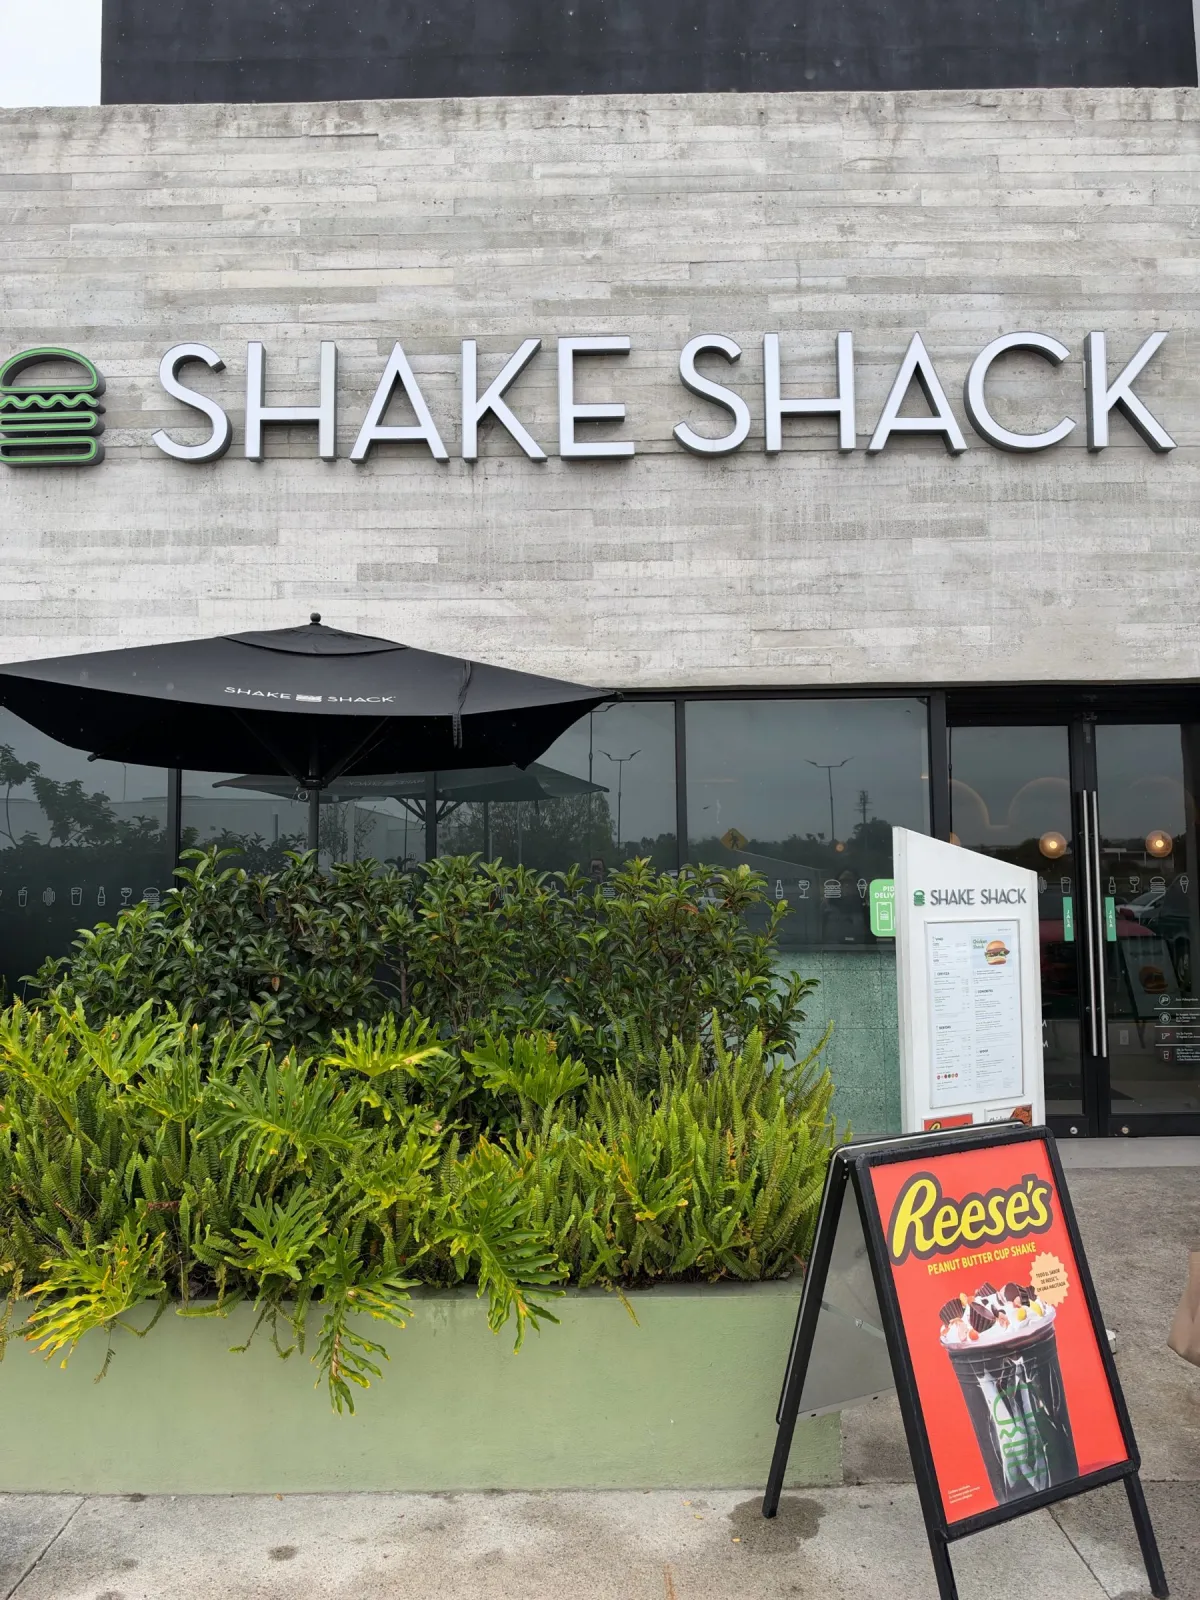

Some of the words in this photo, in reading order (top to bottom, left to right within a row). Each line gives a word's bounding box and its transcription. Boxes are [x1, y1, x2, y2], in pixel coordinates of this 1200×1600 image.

[151, 335, 635, 463] SHAKE
[672, 330, 1178, 457] SHACK
[224, 686, 291, 699] SHAKE
[327, 695, 394, 703] SHACK
[930, 888, 976, 906] SHAKE
[980, 887, 1027, 905] SHACK
[927, 1258, 961, 1275] PEANUT
[961, 1251, 994, 1268] BUTTER
[993, 1247, 1010, 1261] CUP
[1010, 1241, 1037, 1257] SHAKE
